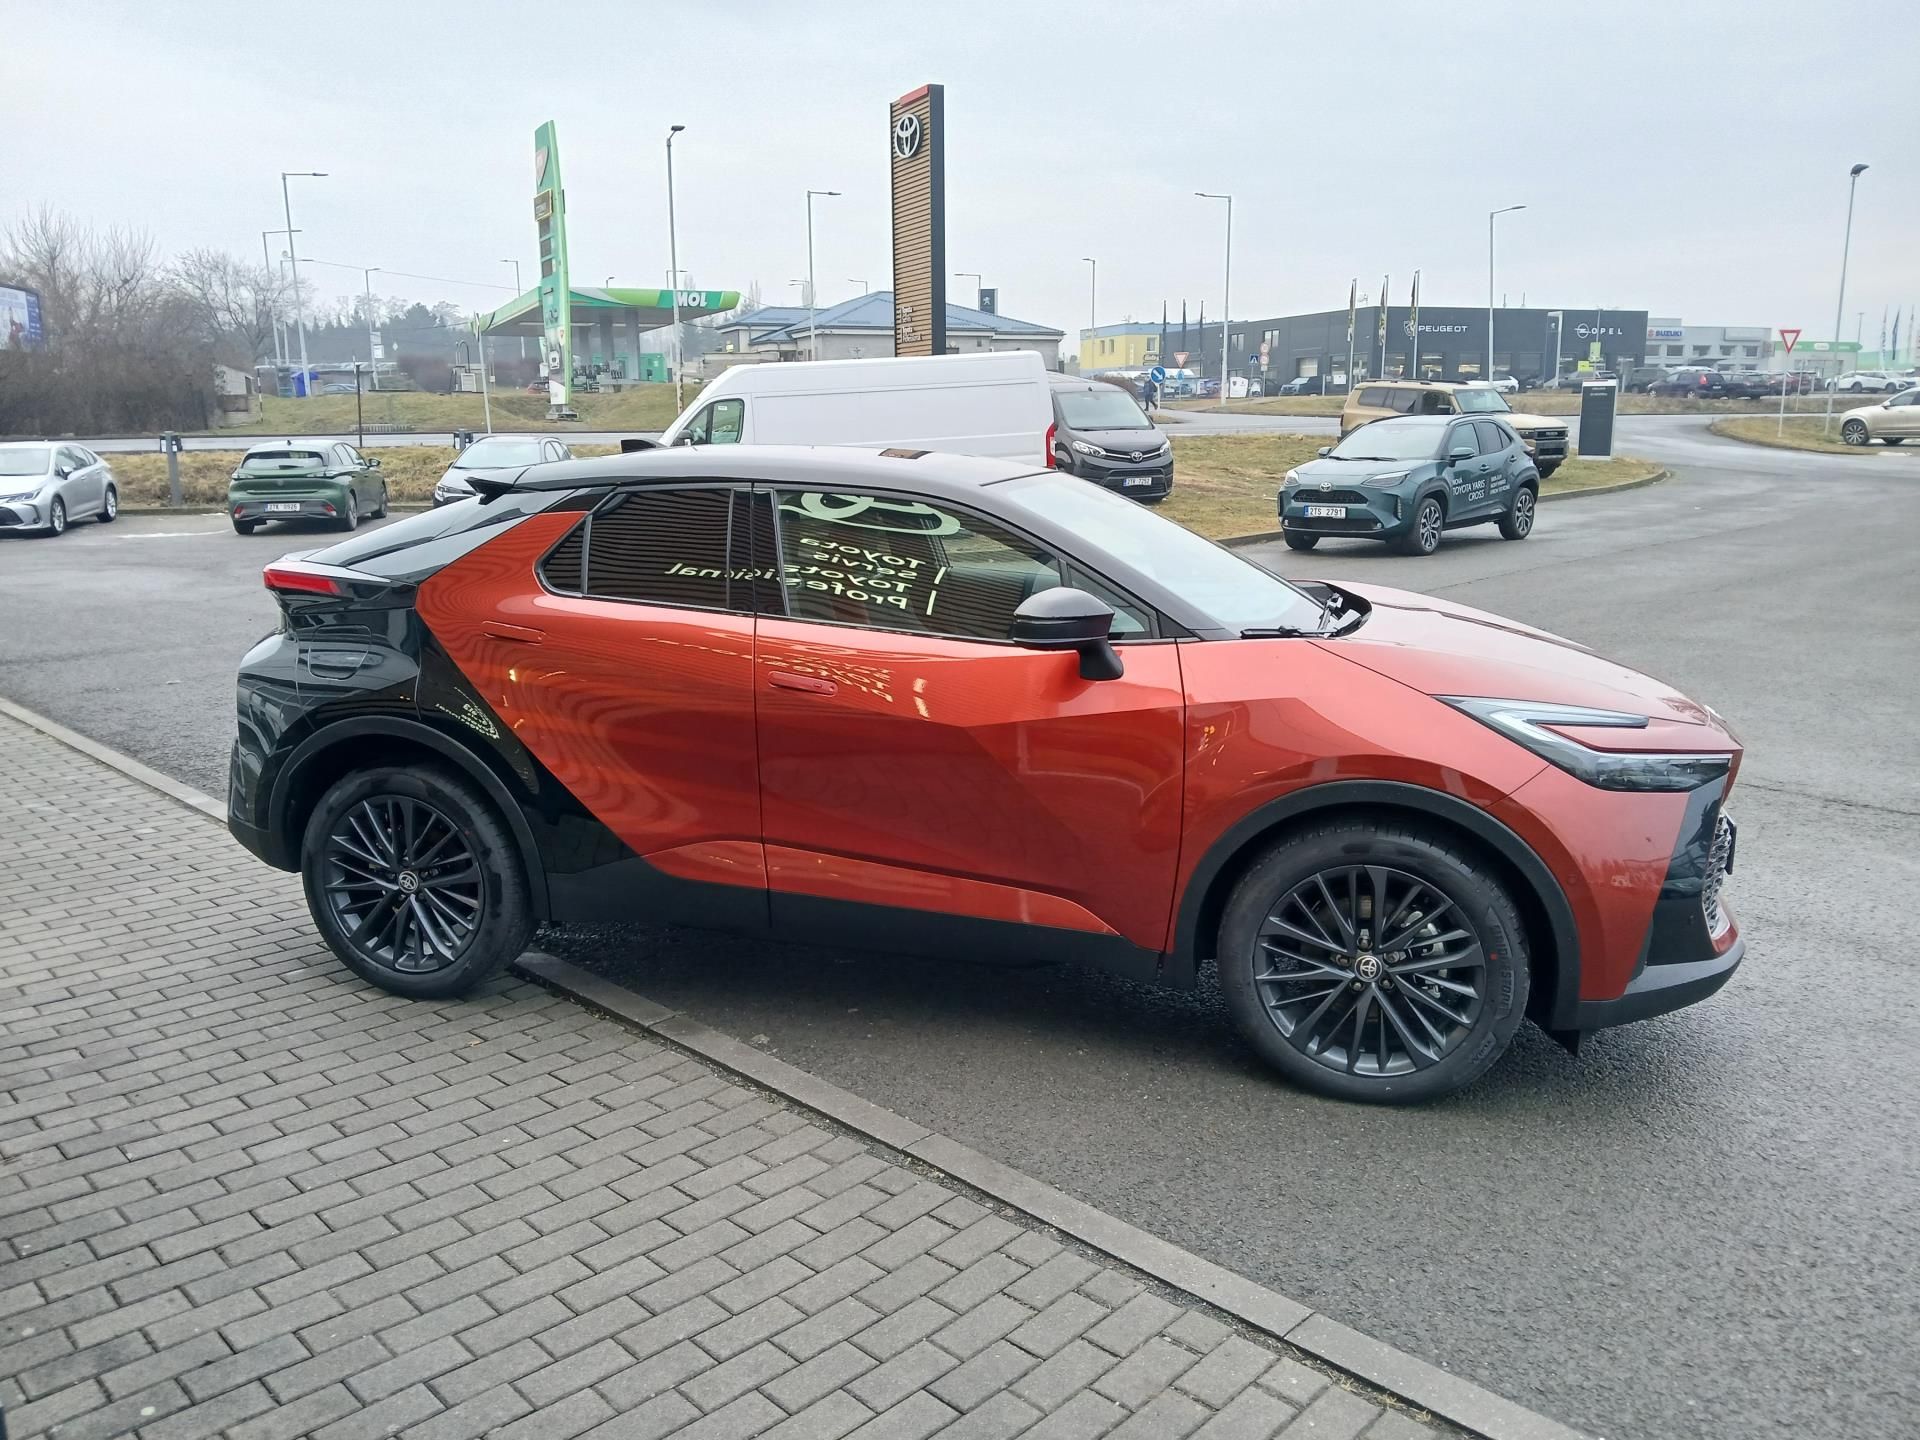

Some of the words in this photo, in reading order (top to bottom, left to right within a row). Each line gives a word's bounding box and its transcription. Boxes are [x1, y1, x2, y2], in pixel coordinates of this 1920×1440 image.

[677, 291, 707, 307] MOL
[1591, 327, 1623, 335] OPEL
[1453, 483, 1471, 495] TOYOTA
[1468, 490, 1484, 501] CROSS
[1310, 508, 1321, 516] 2TS
[1326, 508, 1342, 516] 2791
